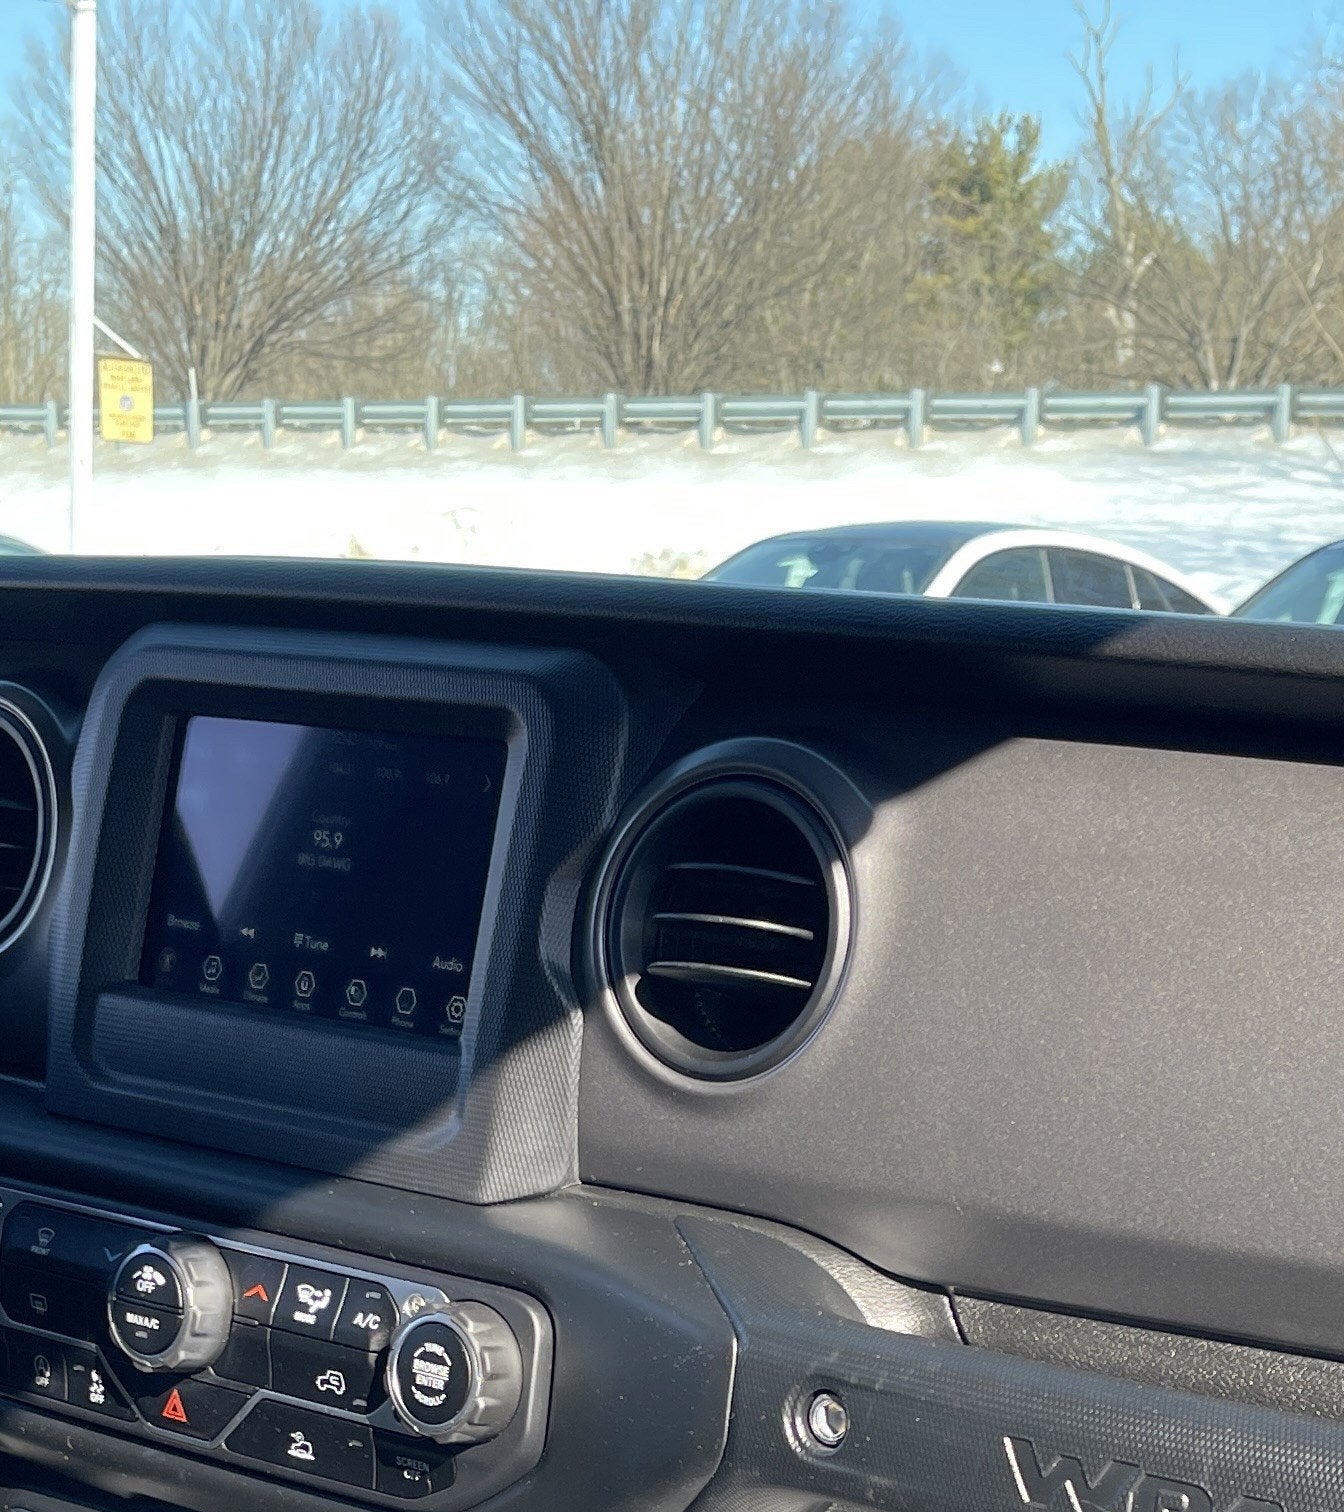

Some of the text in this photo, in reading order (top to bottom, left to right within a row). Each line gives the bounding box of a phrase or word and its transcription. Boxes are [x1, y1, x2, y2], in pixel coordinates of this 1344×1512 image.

[433, 956, 463, 973] Audio
[136, 1279, 156, 1293] OFF
[352, 1312, 381, 1330] A/C
[412, 1358, 450, 1377] BROWSE
[415, 1374, 445, 1391] ENTER
[396, 1455, 430, 1473] SCREEN
